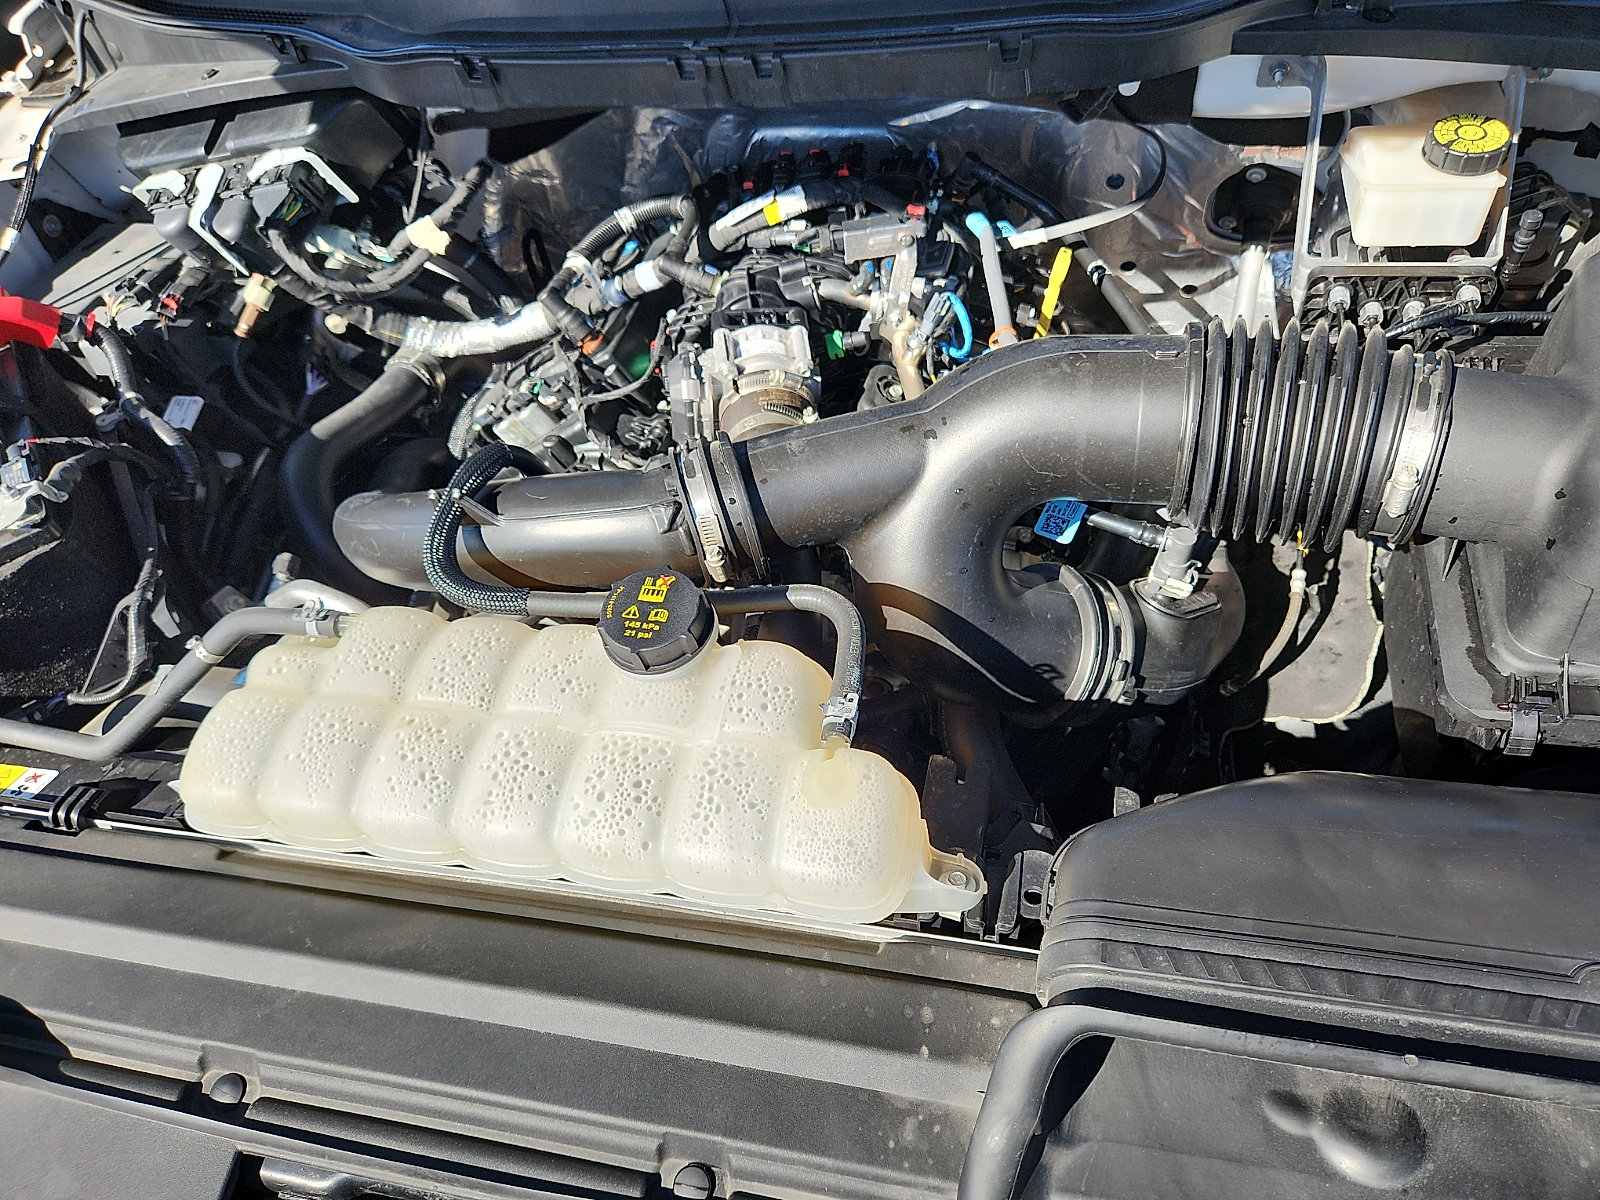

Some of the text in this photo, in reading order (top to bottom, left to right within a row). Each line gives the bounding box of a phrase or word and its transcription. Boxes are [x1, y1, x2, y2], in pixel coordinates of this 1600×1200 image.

[624, 620, 660, 631] 145 kPa
[624, 629, 653, 639] 21 psi
